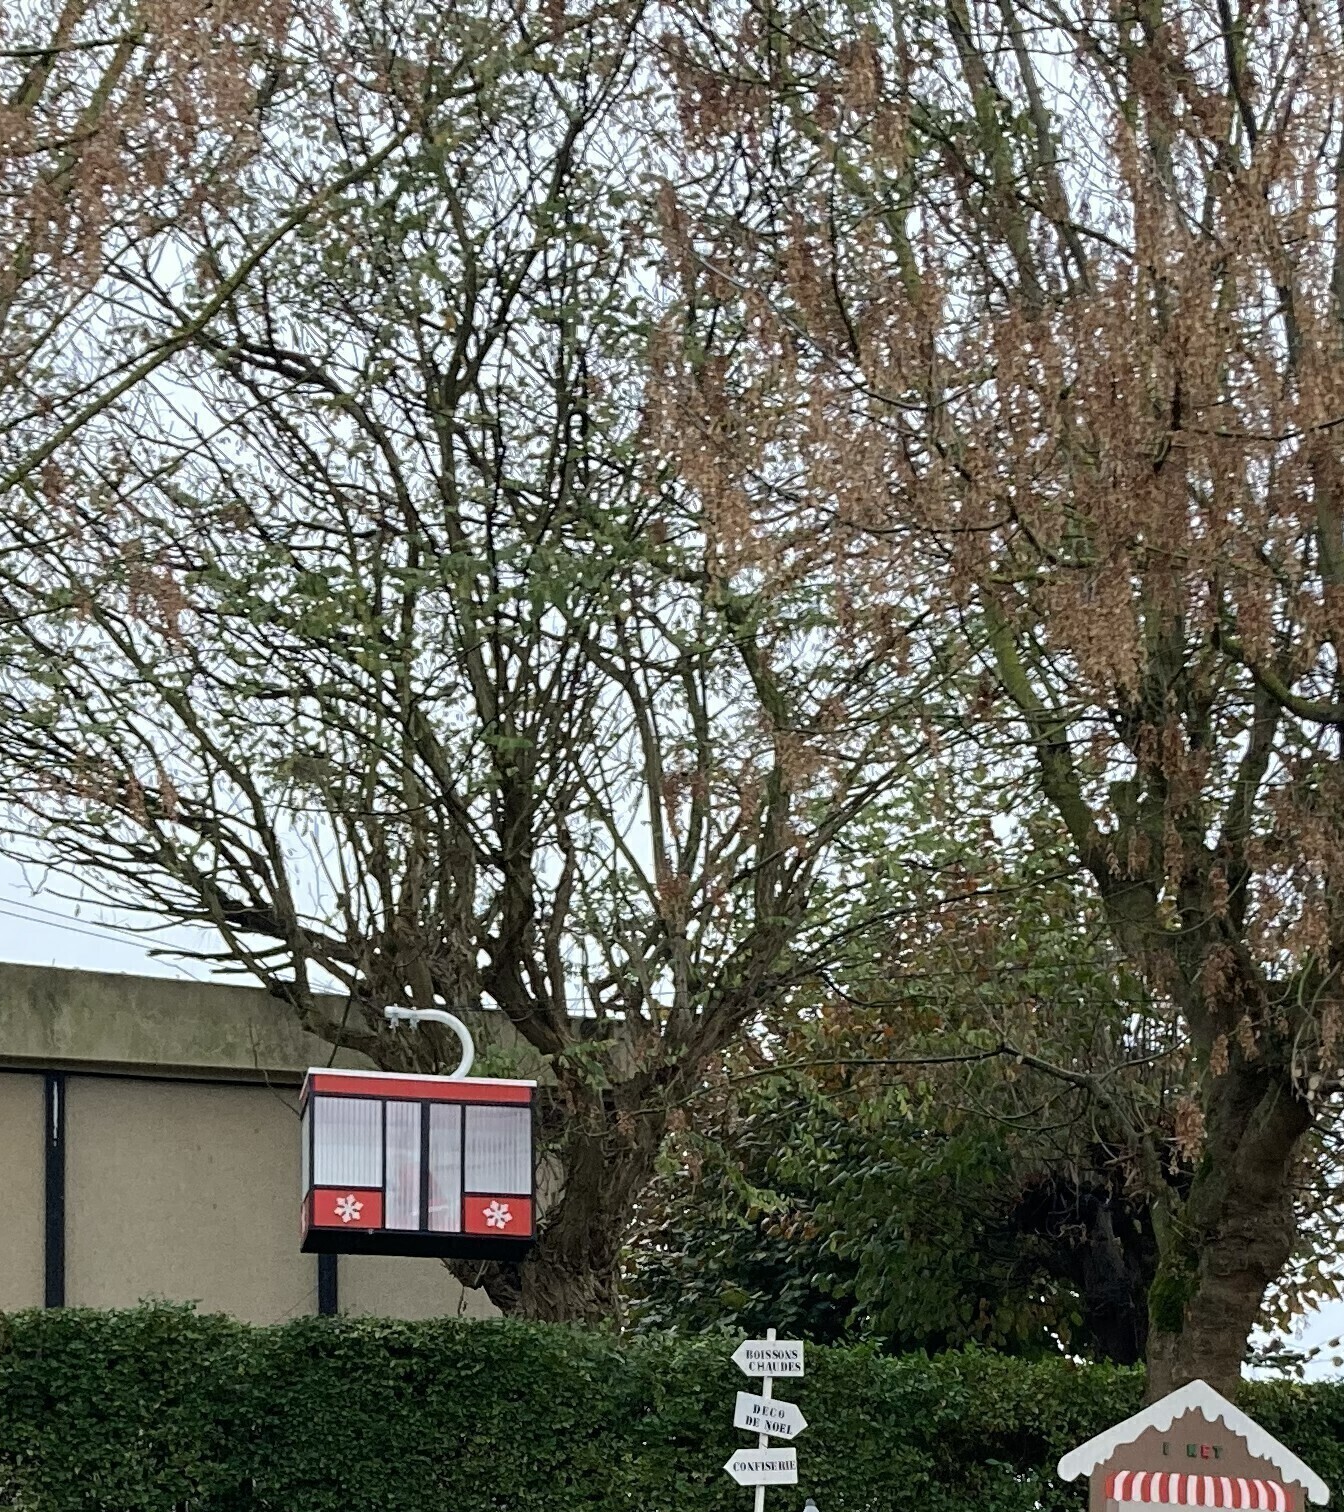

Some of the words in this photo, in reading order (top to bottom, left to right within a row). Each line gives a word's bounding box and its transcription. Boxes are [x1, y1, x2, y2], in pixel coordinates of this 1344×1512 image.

[746, 1350, 798, 1360] BOISSONS
[749, 1361, 801, 1372] CHAUDES
[752, 1404, 785, 1419] DECO
[745, 1415, 760, 1428] DE
[764, 1420, 793, 1435] NOEL
[733, 1461, 795, 1472] CONFISERIE
